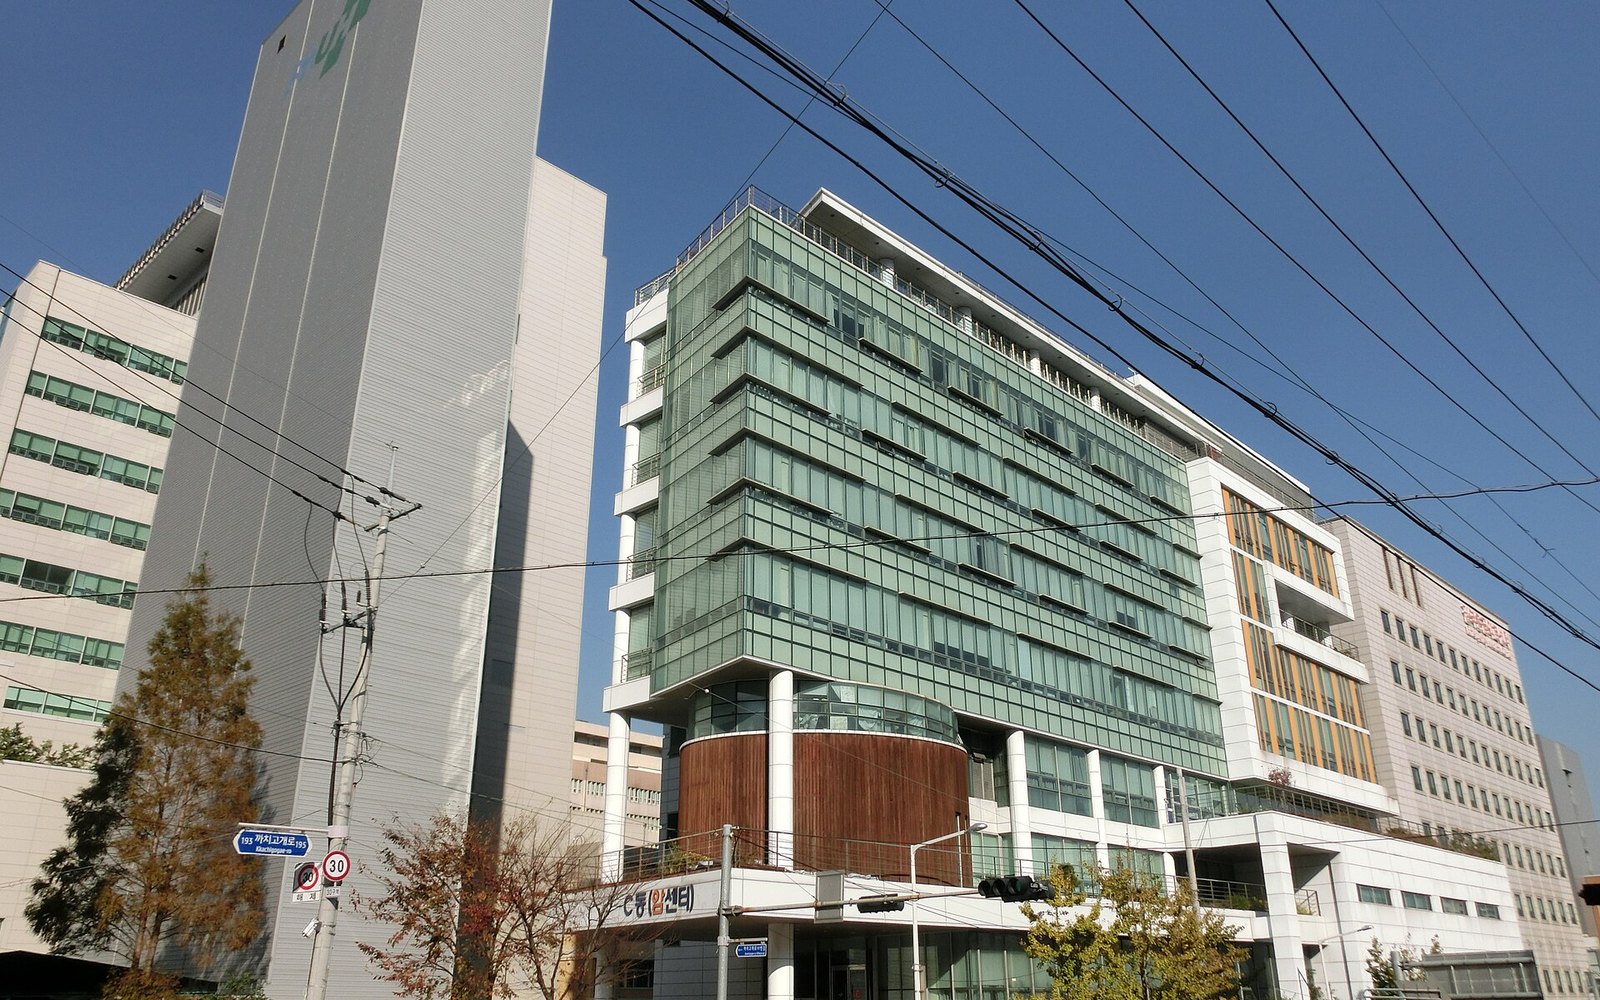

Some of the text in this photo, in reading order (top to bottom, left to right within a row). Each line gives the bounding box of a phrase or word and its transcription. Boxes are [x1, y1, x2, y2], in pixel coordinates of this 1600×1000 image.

[241, 834, 307, 849] 193 까치고개로 195
[329, 859, 344, 873] 30
[302, 872, 314, 882] 30
